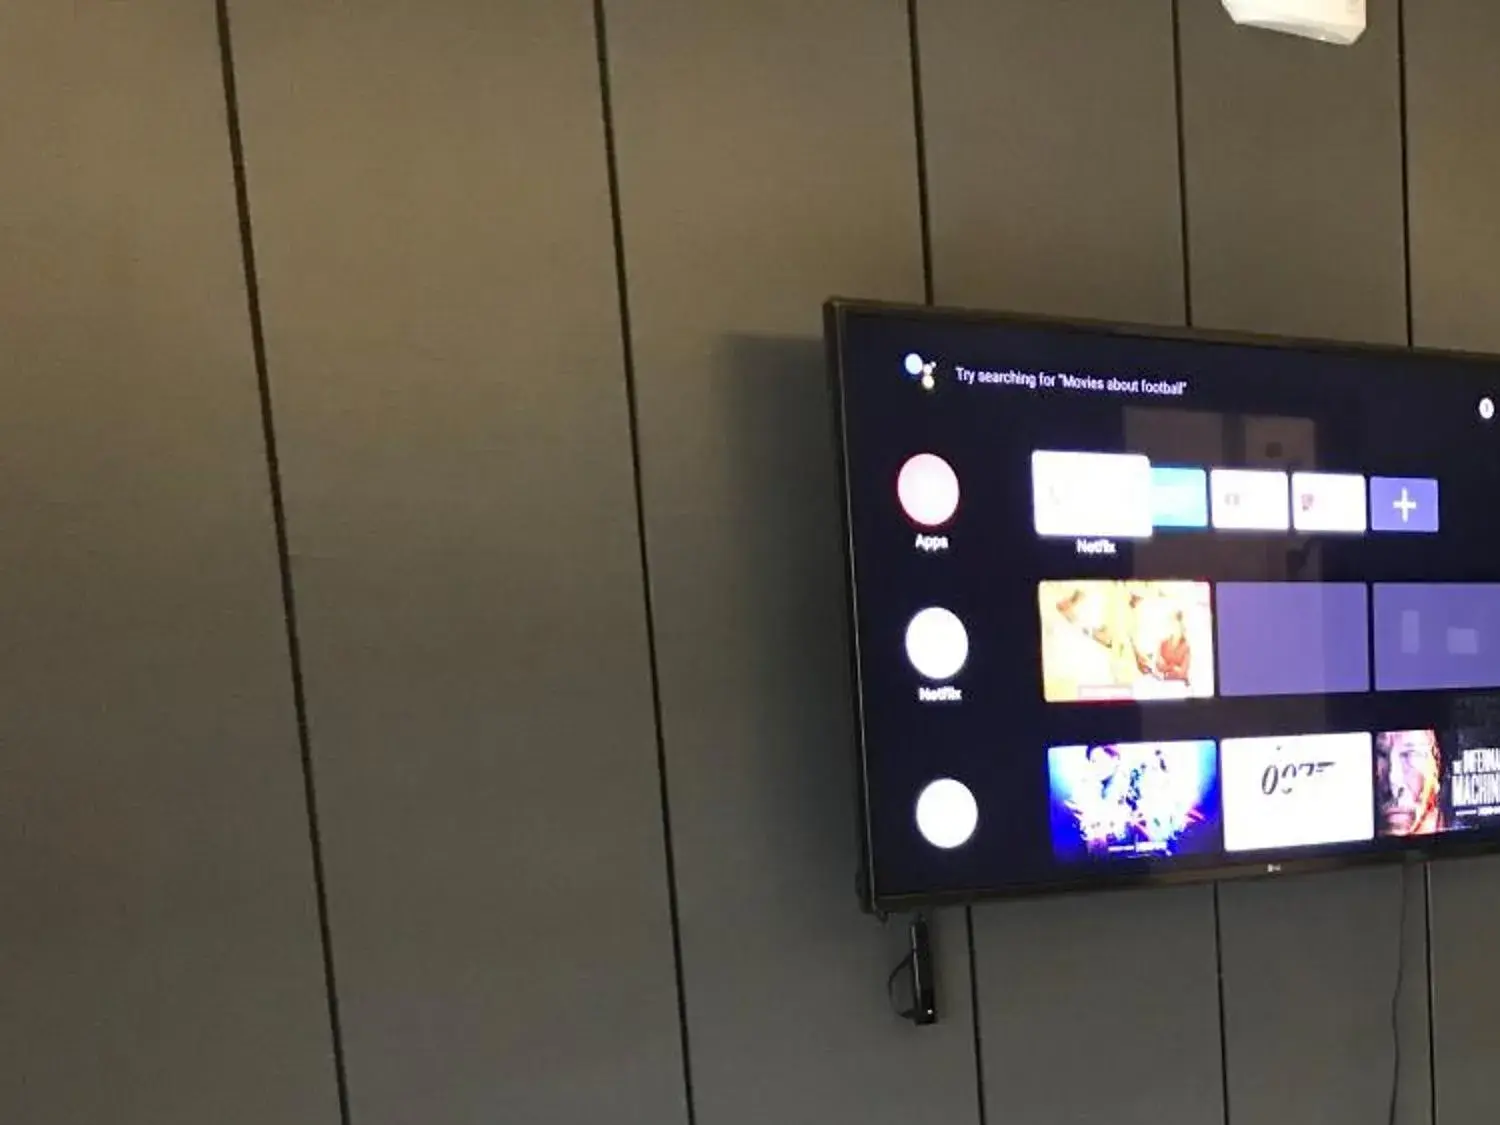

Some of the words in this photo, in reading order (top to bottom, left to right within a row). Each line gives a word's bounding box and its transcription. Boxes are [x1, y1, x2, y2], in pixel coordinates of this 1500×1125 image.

[955, 366, 975, 384] Try
[977, 370, 1036, 389] searching
[1039, 372, 1056, 387] for
[1058, 374, 1104, 391] "Movies
[1106, 377, 1139, 393] about
[915, 534, 949, 551] Apps
